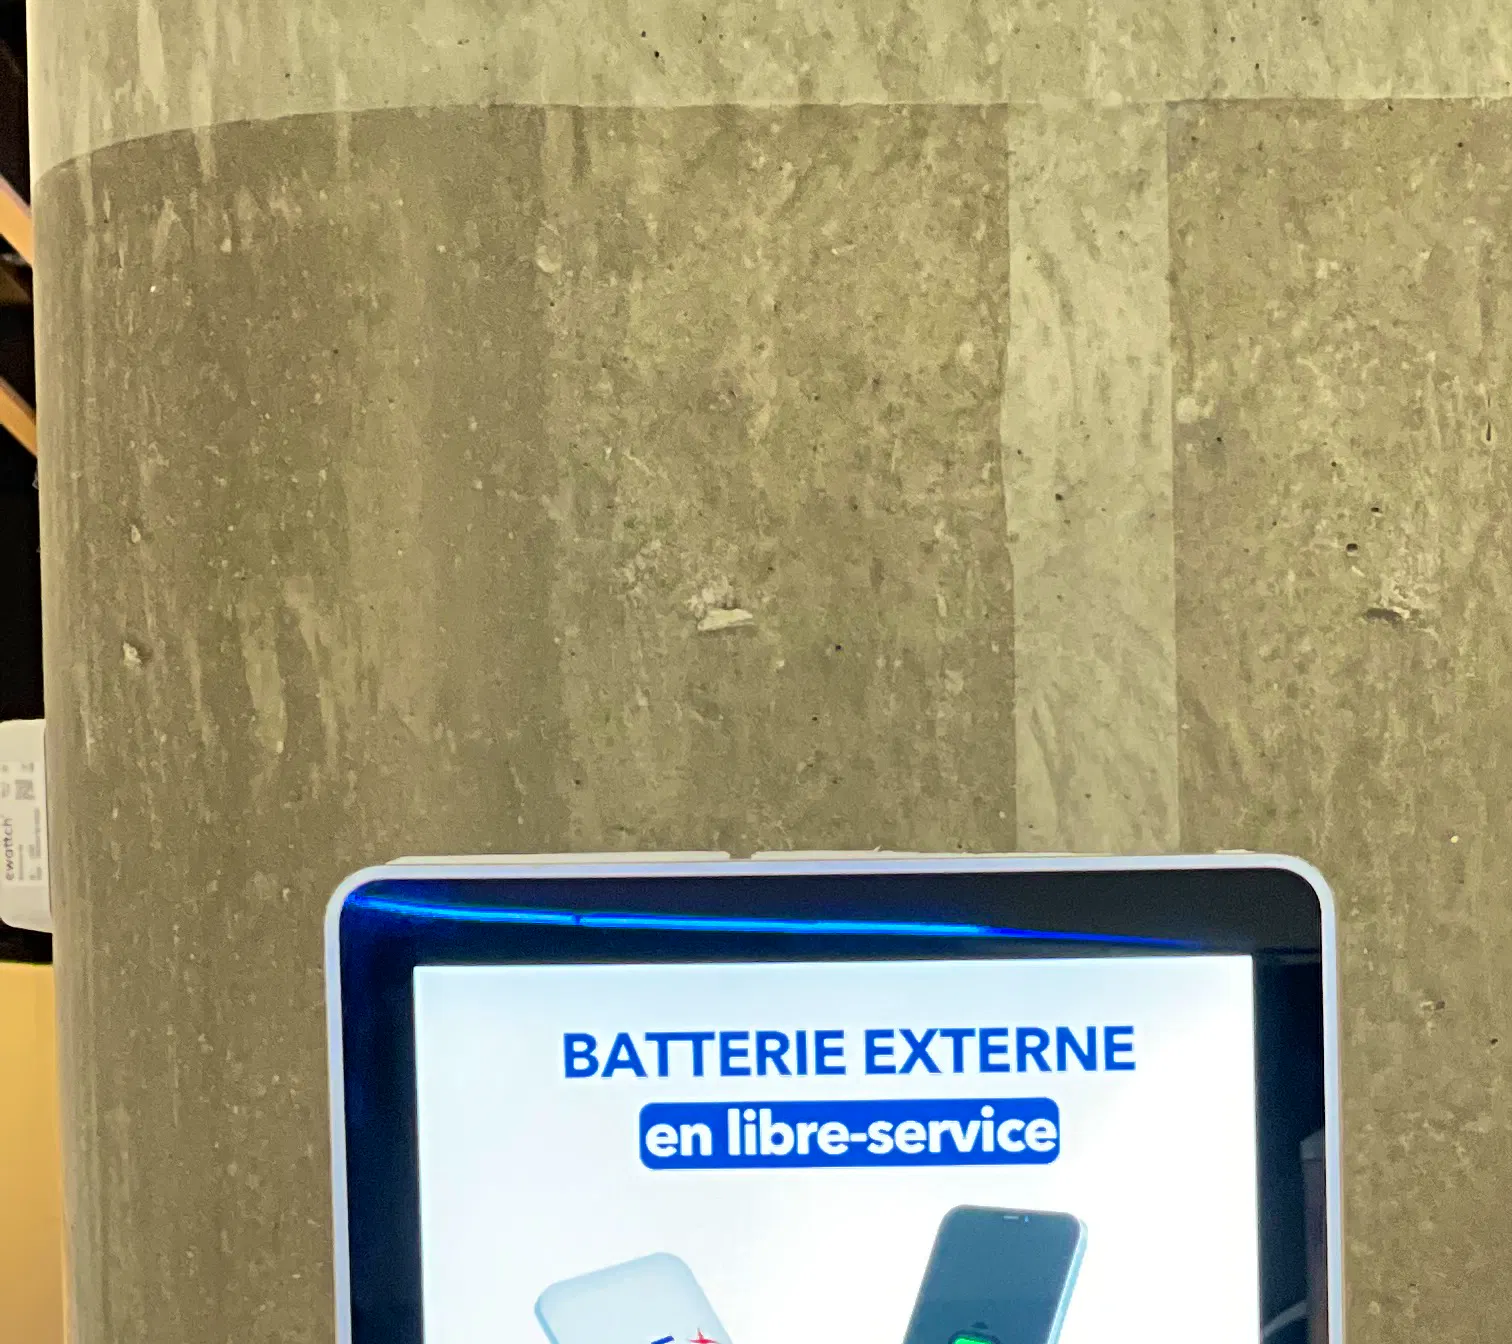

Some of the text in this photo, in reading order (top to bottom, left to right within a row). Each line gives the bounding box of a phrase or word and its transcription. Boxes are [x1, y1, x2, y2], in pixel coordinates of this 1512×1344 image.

[563, 1025, 1137, 1079] BATTERIE EXTERNE
[645, 1105, 1058, 1157] en libre-service
